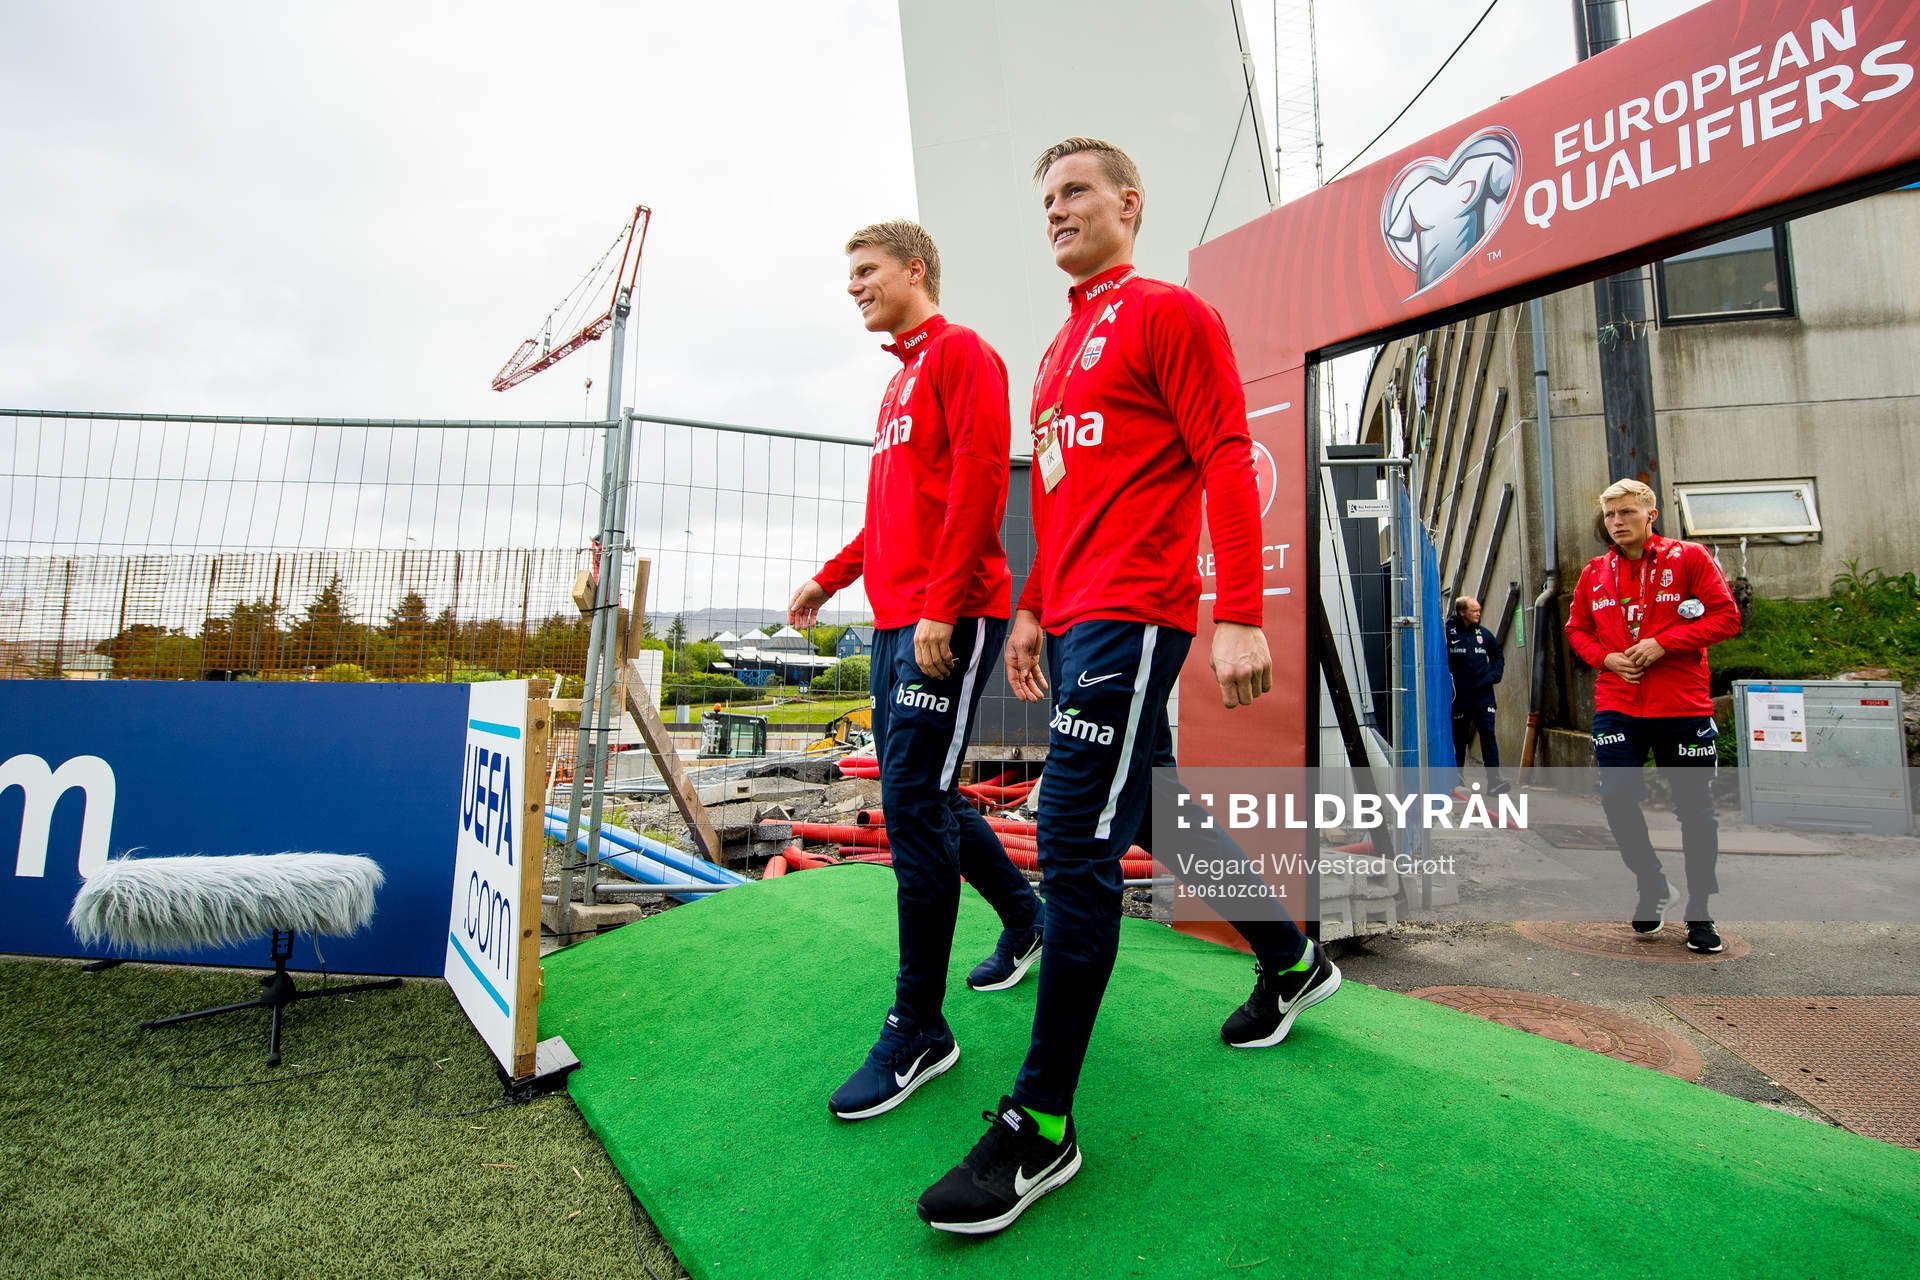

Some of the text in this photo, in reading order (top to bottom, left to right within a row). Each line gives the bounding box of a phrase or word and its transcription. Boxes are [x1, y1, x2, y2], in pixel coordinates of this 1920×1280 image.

[1523, 40, 1914, 229] QUALIFIERS
[1554, 6, 1857, 167] EUROPEAN
[1486, 249, 1502, 262] TM
[1197, 543, 1290, 577] RECT
[1656, 593, 1681, 603] ama
[463, 743, 514, 867] UEFA
[463, 870, 512, 981] .com
